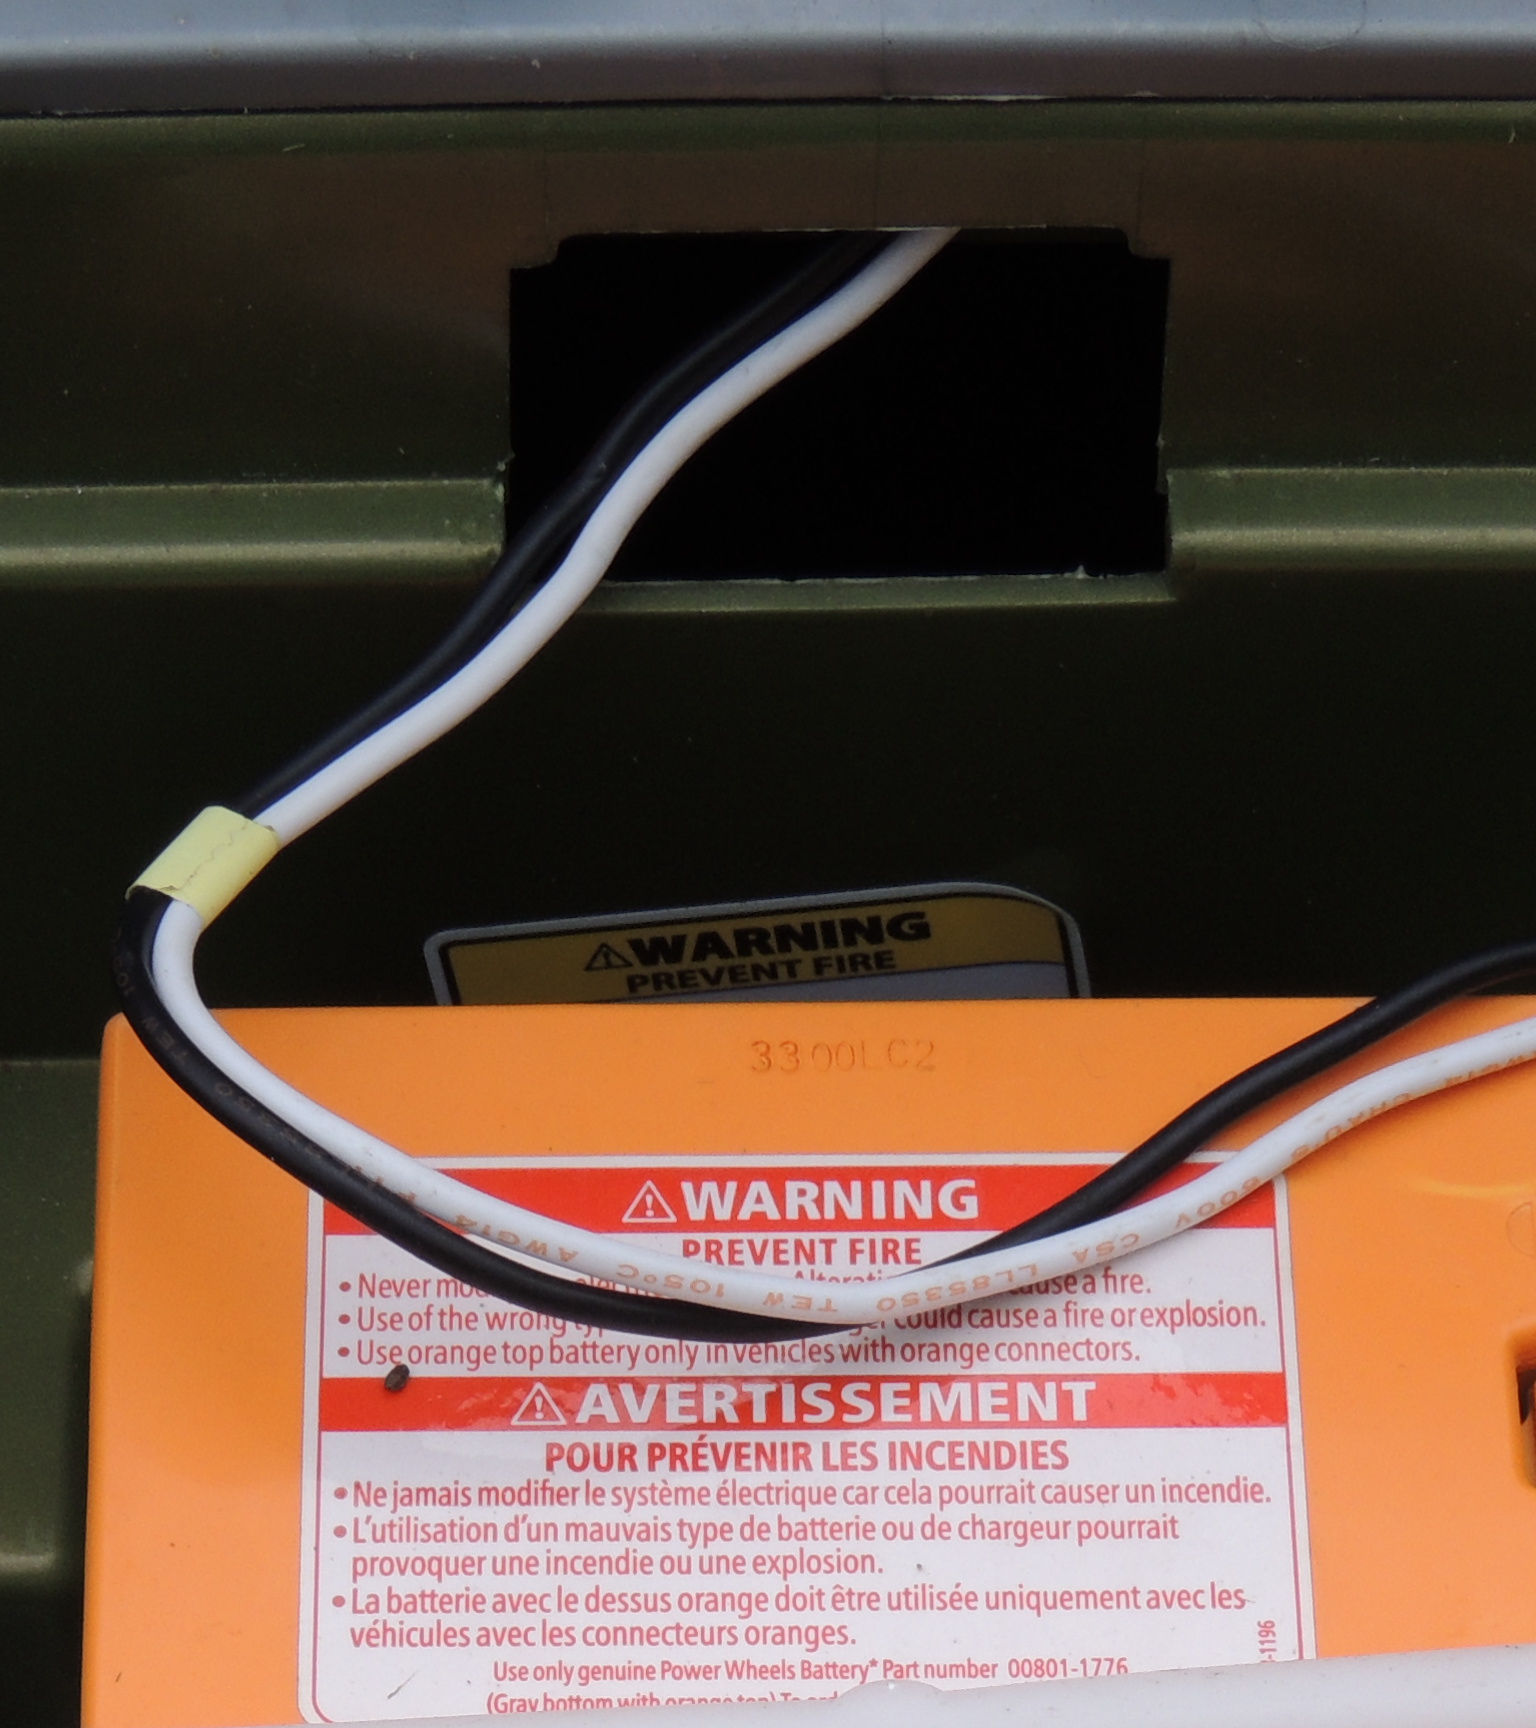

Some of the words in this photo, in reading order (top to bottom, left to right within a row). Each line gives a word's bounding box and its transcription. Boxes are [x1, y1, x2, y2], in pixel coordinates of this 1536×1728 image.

[629, 911, 932, 967] WARNING
[626, 956, 803, 994] PREVENT
[813, 950, 897, 977] FIRE
[680, 1179, 979, 1221] WARNING
[682, 1237, 844, 1266] PREVENT
[849, 1237, 923, 1265] FIRE
[1072, 1232, 1141, 1264] CSA
[356, 1273, 432, 1299] Never
[1081, 1272, 1100, 1296] a
[1102, 1267, 1152, 1295] fire.
[356, 1306, 402, 1331] Use
[406, 1304, 435, 1331] of
[437, 1305, 479, 1331] the
[967, 1305, 1041, 1330] cause
[1043, 1306, 1059, 1330] a
[1064, 1301, 1105, 1330] fire
[1110, 1305, 1139, 1329] or
[1140, 1301, 1266, 1335] explosion.
[764, 1291, 838, 1314] TEW
[356, 1339, 402, 1365] Use
[407, 1345, 500, 1371] orange
[502, 1341, 545, 1371] top
[549, 1338, 642, 1371] battery
[645, 1339, 701, 1370] only
[707, 1340, 729, 1364] in
[730, 1339, 837, 1364] vehicles
[839, 1336, 896, 1364] with
[900, 1341, 991, 1369] orange
[994, 1336, 1142, 1363] connectors.
[574, 1381, 1096, 1424] AVERTISSEMENT
[545, 1441, 641, 1473] POUR
[647, 1434, 813, 1473] PRÉVENIR
[821, 1441, 878, 1471] LES
[887, 1439, 1070, 1472] INCENDIES
[352, 1482, 388, 1508] Ne
[390, 1482, 473, 1514] jamais
[482, 1479, 581, 1508] modifier
[585, 1479, 609, 1507] le
[611, 1479, 711, 1513] système
[716, 1478, 837, 1512] électrique
[842, 1483, 880, 1505] car
[884, 1478, 932, 1505] cela
[938, 1478, 1036, 1511] pourrait
[1040, 1482, 1120, 1504] causer
[1125, 1481, 1155, 1503] un
[1160, 1476, 1271, 1504] incendie.
[352, 1515, 499, 1545] L'utilisation
[503, 1514, 558, 1544] d'un
[564, 1516, 672, 1543] mauvais
[676, 1517, 735, 1550] type
[739, 1513, 772, 1542] de
[777, 1514, 876, 1542] batterie
[882, 1518, 914, 1541] ou
[920, 1514, 952, 1541] de
[957, 1514, 1072, 1547] chargeur
[1077, 1512, 1179, 1546] pourrait
[351, 1553, 487, 1584] provoquer
[492, 1553, 540, 1578] une
[545, 1547, 654, 1577] incendie
[659, 1553, 693, 1577] ou
[697, 1552, 747, 1576] une
[751, 1547, 884, 1582] explosion.
[352, 1588, 379, 1615] La
[386, 1586, 486, 1614] batterie
[492, 1590, 552, 1613] avec
[556, 1585, 579, 1613] le
[584, 1585, 672, 1613] dessus
[677, 1590, 768, 1620] orange
[774, 1583, 826, 1612] doit
[831, 1583, 881, 1612] être
[888, 1583, 979, 1611] utilisée
[985, 1583, 1141, 1617] uniquement
[1146, 1586, 1206, 1611] avec
[1210, 1582, 1247, 1610] les
[350, 1619, 471, 1648] véhicules
[475, 1624, 537, 1648] avec
[541, 1619, 577, 1647] les
[582, 1621, 738, 1647] connecteurs
[744, 1624, 857, 1652] oranges.
[493, 1661, 529, 1682] Use
[533, 1660, 575, 1686] only
[577, 1660, 657, 1686] genuine
[661, 1660, 721, 1682] Power
[725, 1658, 796, 1681] Wheels
[882, 1659, 920, 1680] Part
[924, 1658, 999, 1680] number
[1007, 1657, 1130, 1679] 00801-1776
